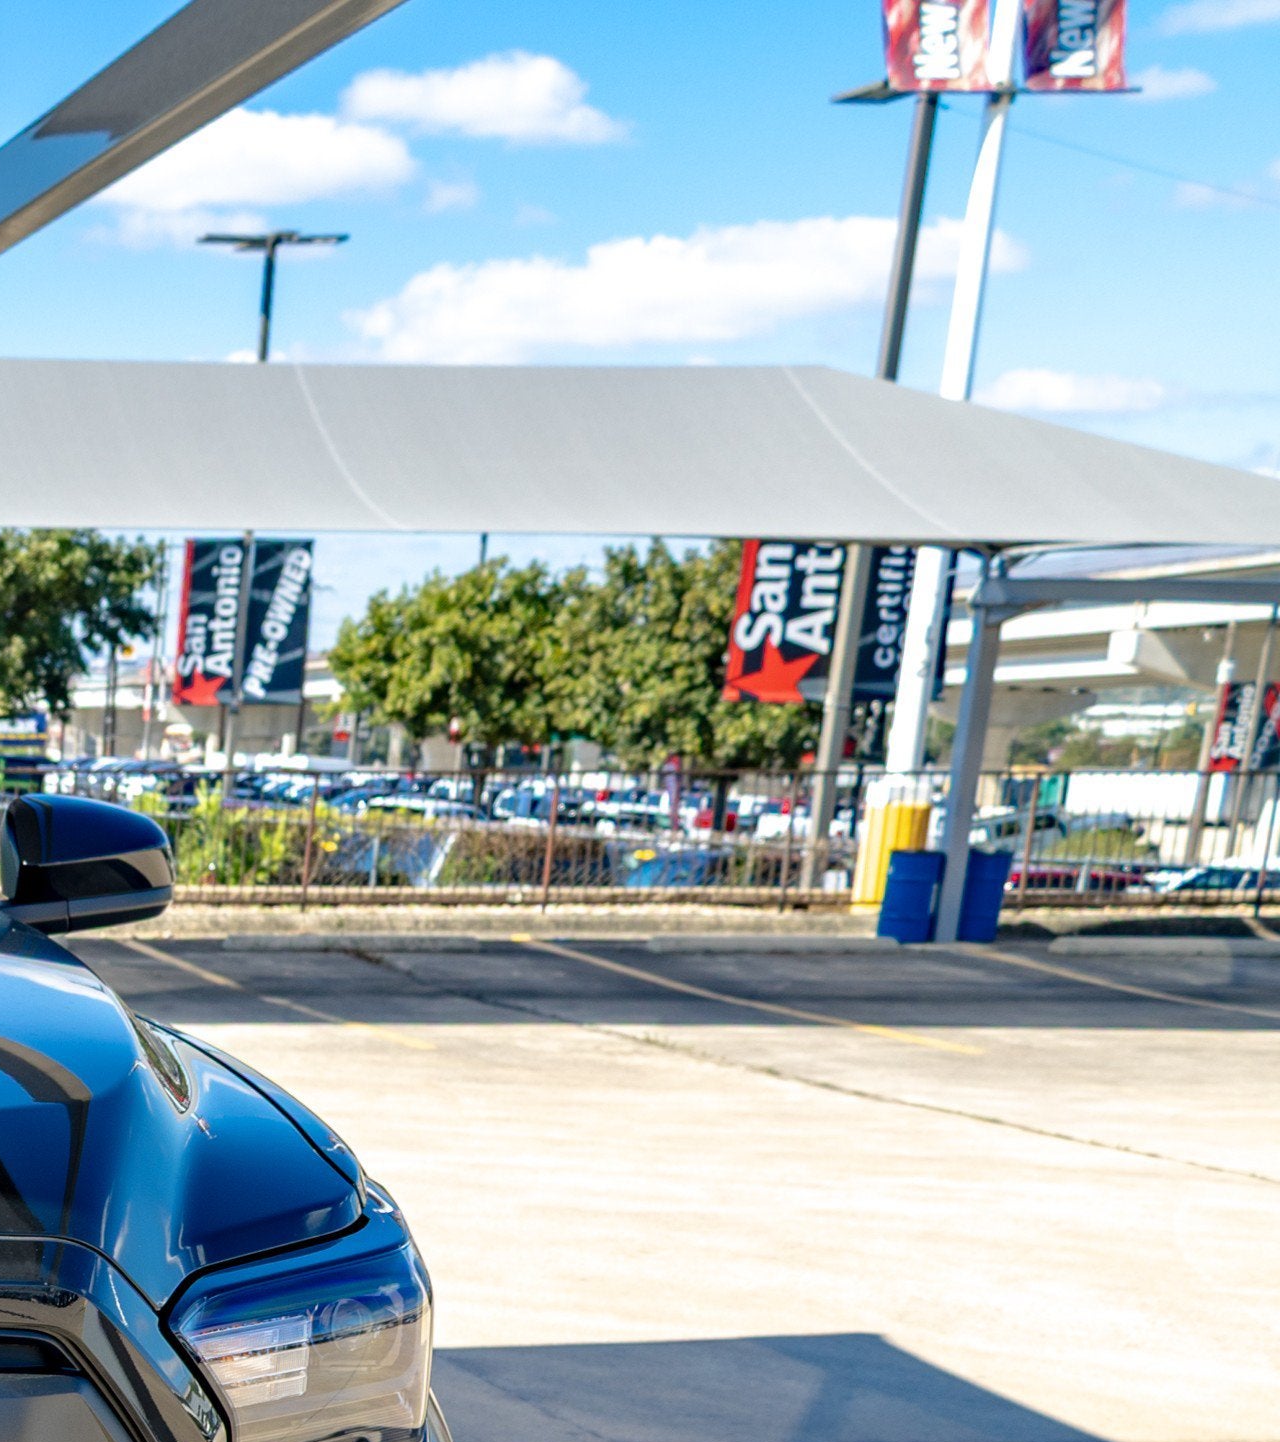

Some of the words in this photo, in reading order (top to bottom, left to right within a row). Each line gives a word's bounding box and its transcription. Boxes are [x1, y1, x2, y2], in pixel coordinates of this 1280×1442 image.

[913, 3, 961, 79] New
[1048, 0, 1098, 78] New
[204, 545, 243, 678] Antonio
[243, 547, 313, 700] PRE-OWNED
[734, 543, 794, 652] San
[177, 613, 208, 678] San
